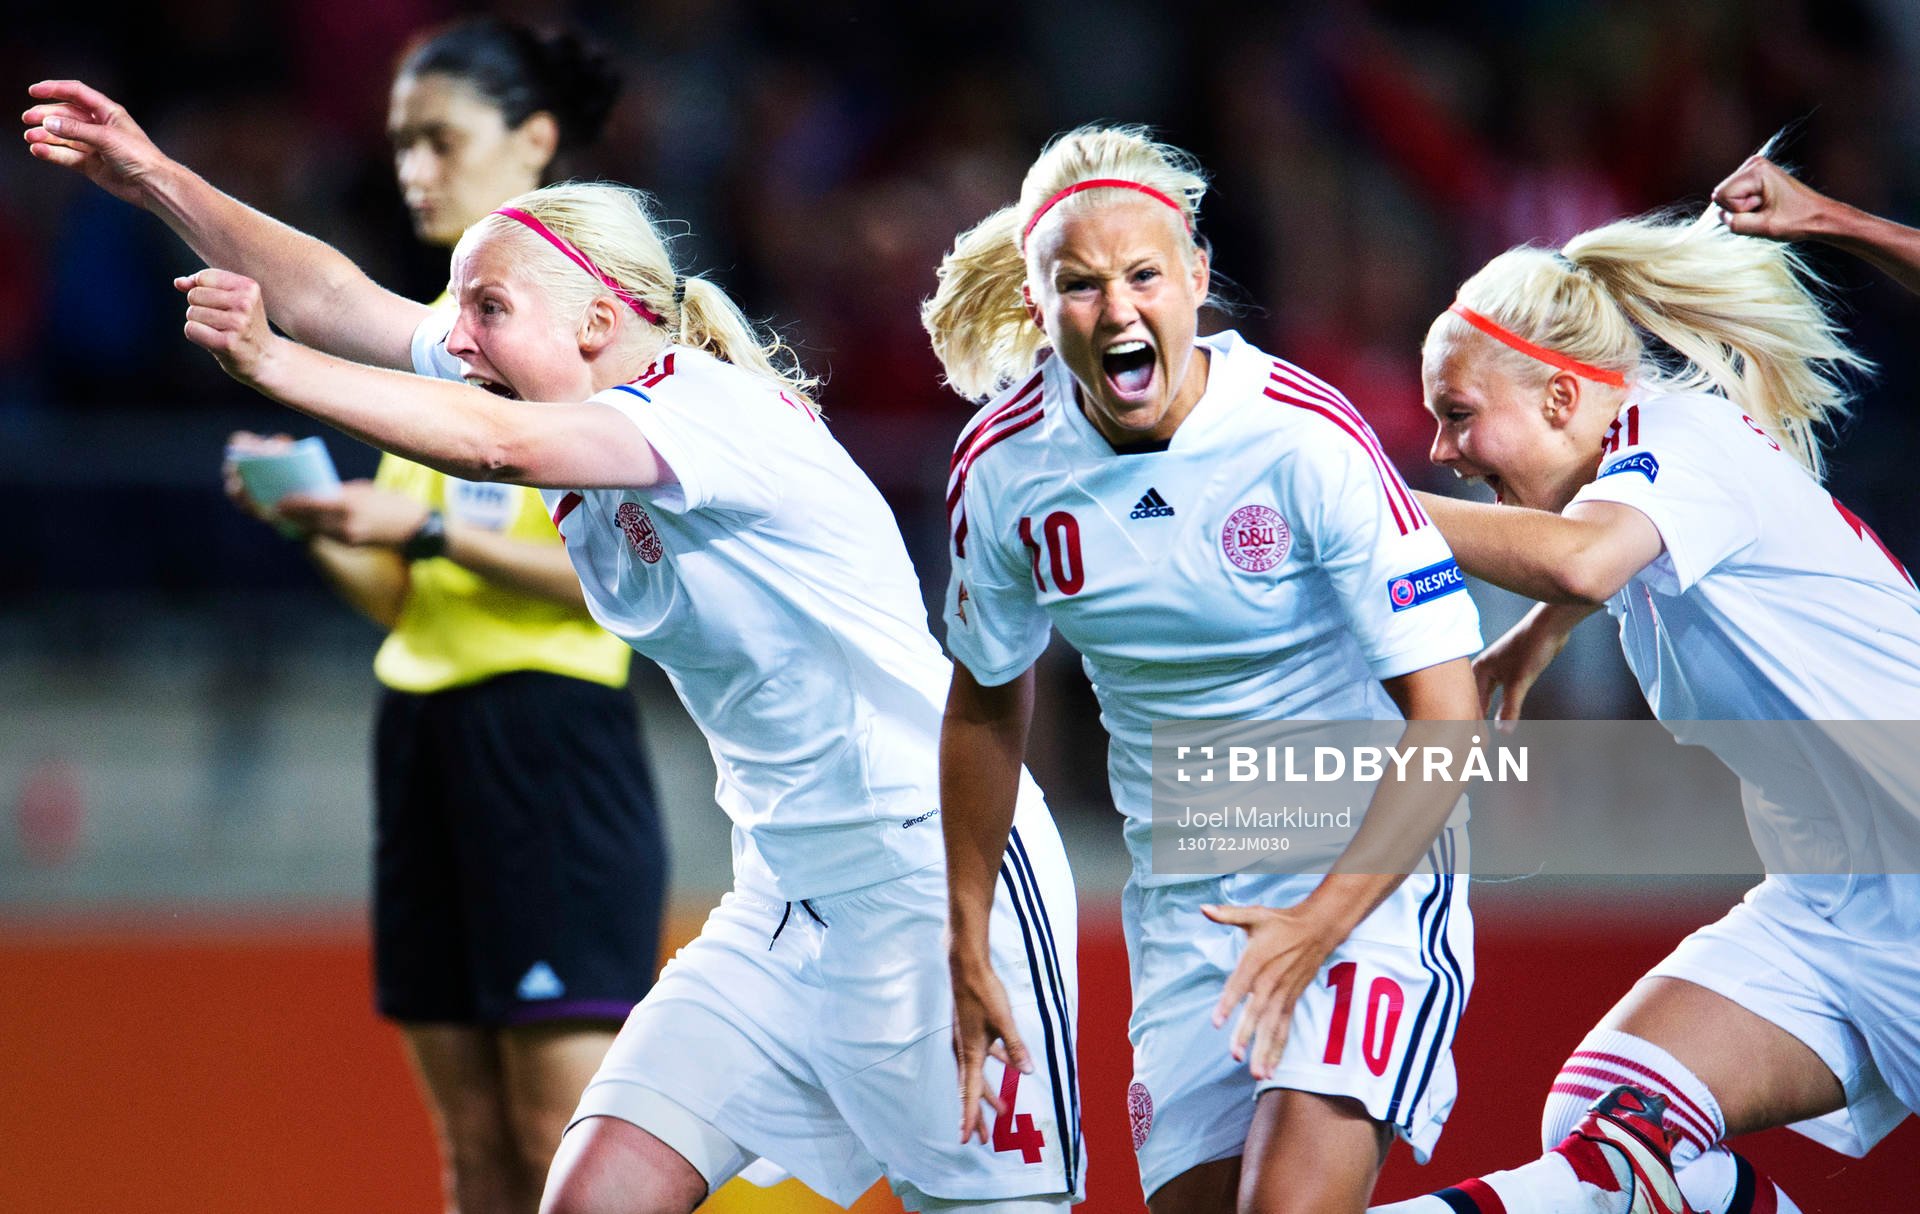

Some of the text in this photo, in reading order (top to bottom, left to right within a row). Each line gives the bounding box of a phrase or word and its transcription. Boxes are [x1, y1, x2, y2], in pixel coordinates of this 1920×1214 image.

[1018, 510, 1085, 596] 10
[1130, 506, 1175, 520] adidas
[1322, 961, 1405, 1077] 10
[992, 1062, 1046, 1164] 4
